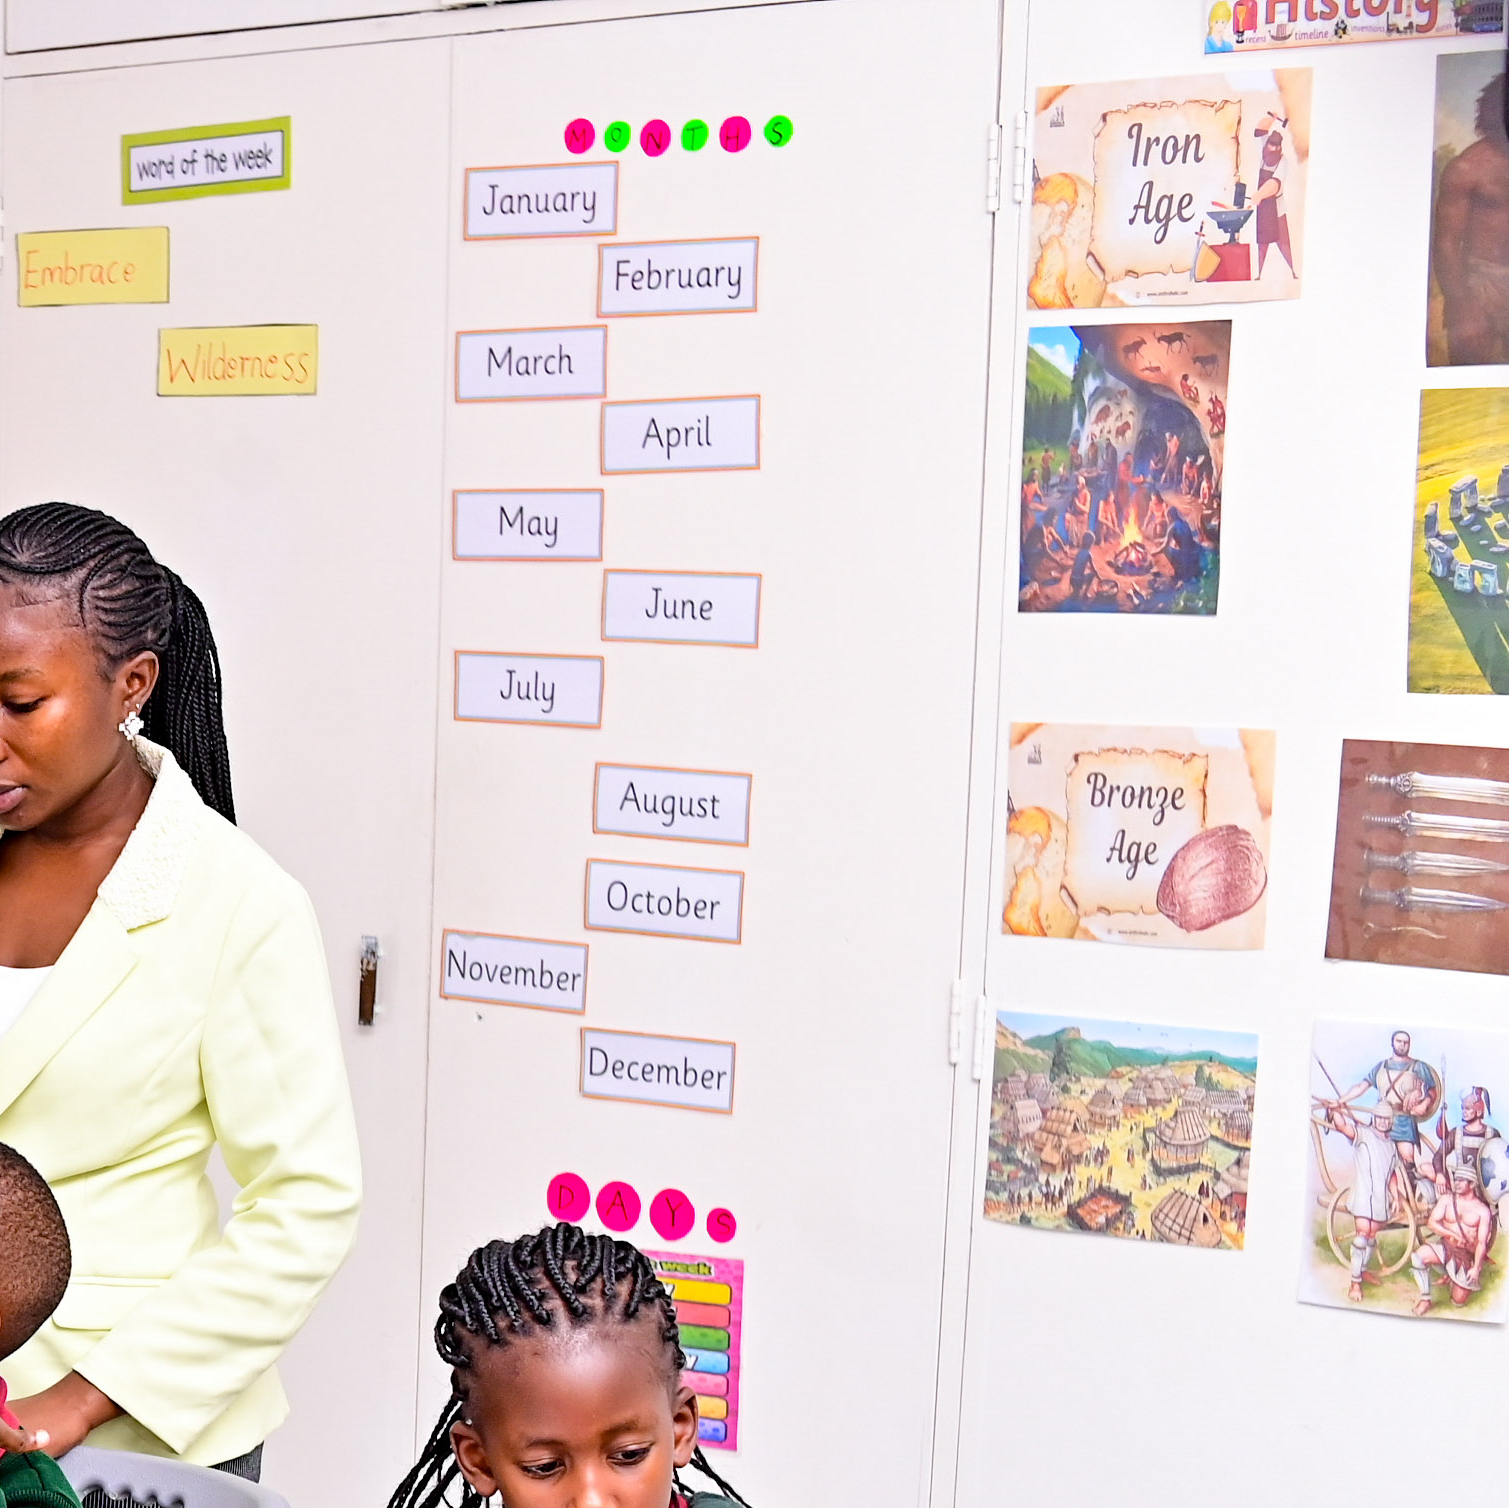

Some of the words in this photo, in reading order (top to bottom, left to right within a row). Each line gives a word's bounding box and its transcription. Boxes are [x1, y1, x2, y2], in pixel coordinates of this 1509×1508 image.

[1246, 35, 1266, 44] recent
[1295, 29, 1329, 40] timeline
[568, 121, 783, 152] MONTHS
[1127, 123, 1205, 167] Iron
[136, 156, 174, 181] word
[181, 149, 197, 176] of
[204, 148, 228, 174] the
[233, 142, 273, 170] week
[482, 184, 596, 223] January
[1128, 180, 1196, 245] Age
[24, 250, 136, 289] Embrace
[615, 259, 742, 300] February
[166, 342, 309, 384] Wilderness
[487, 344, 574, 378] March
[642, 415, 712, 460] April
[499, 505, 559, 548] May
[645, 587, 714, 622] June
[500, 669, 556, 714] July
[619, 781, 721, 827] August
[1086, 771, 1185, 826] Bronze
[1106, 828, 1160, 881] Age
[607, 879, 721, 921] October
[447, 948, 582, 993] November
[588, 1047, 727, 1091] December
[661, 1260, 715, 1276] week
